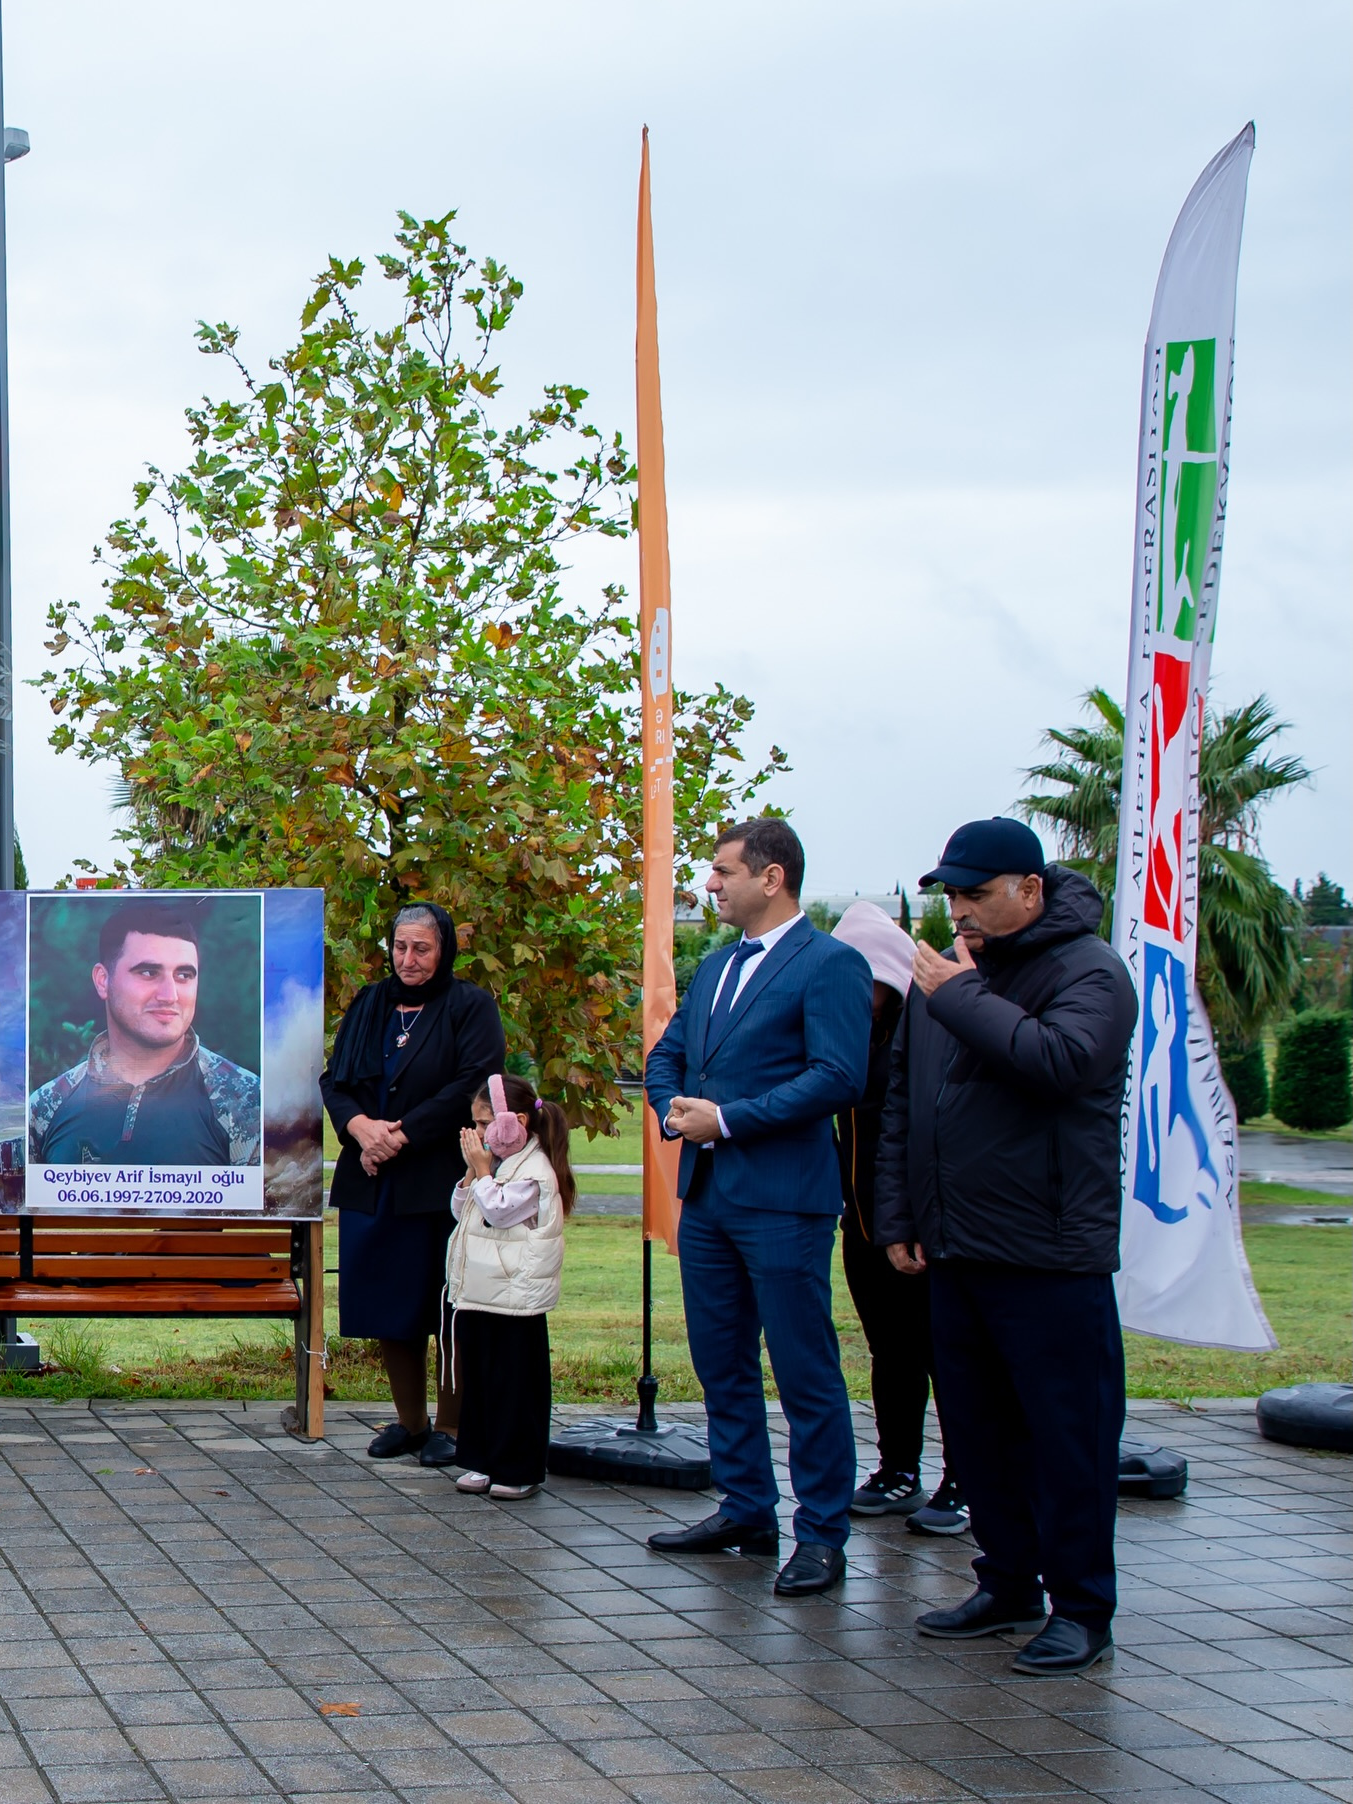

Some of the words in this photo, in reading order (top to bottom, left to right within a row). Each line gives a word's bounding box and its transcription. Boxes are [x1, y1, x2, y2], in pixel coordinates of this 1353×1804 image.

[43, 1169, 111, 1185] Qeybiyev
[115, 1170, 144, 1183] Arif
[149, 1167, 202, 1184] İsmayıl
[211, 1170, 244, 1187] oğlu
